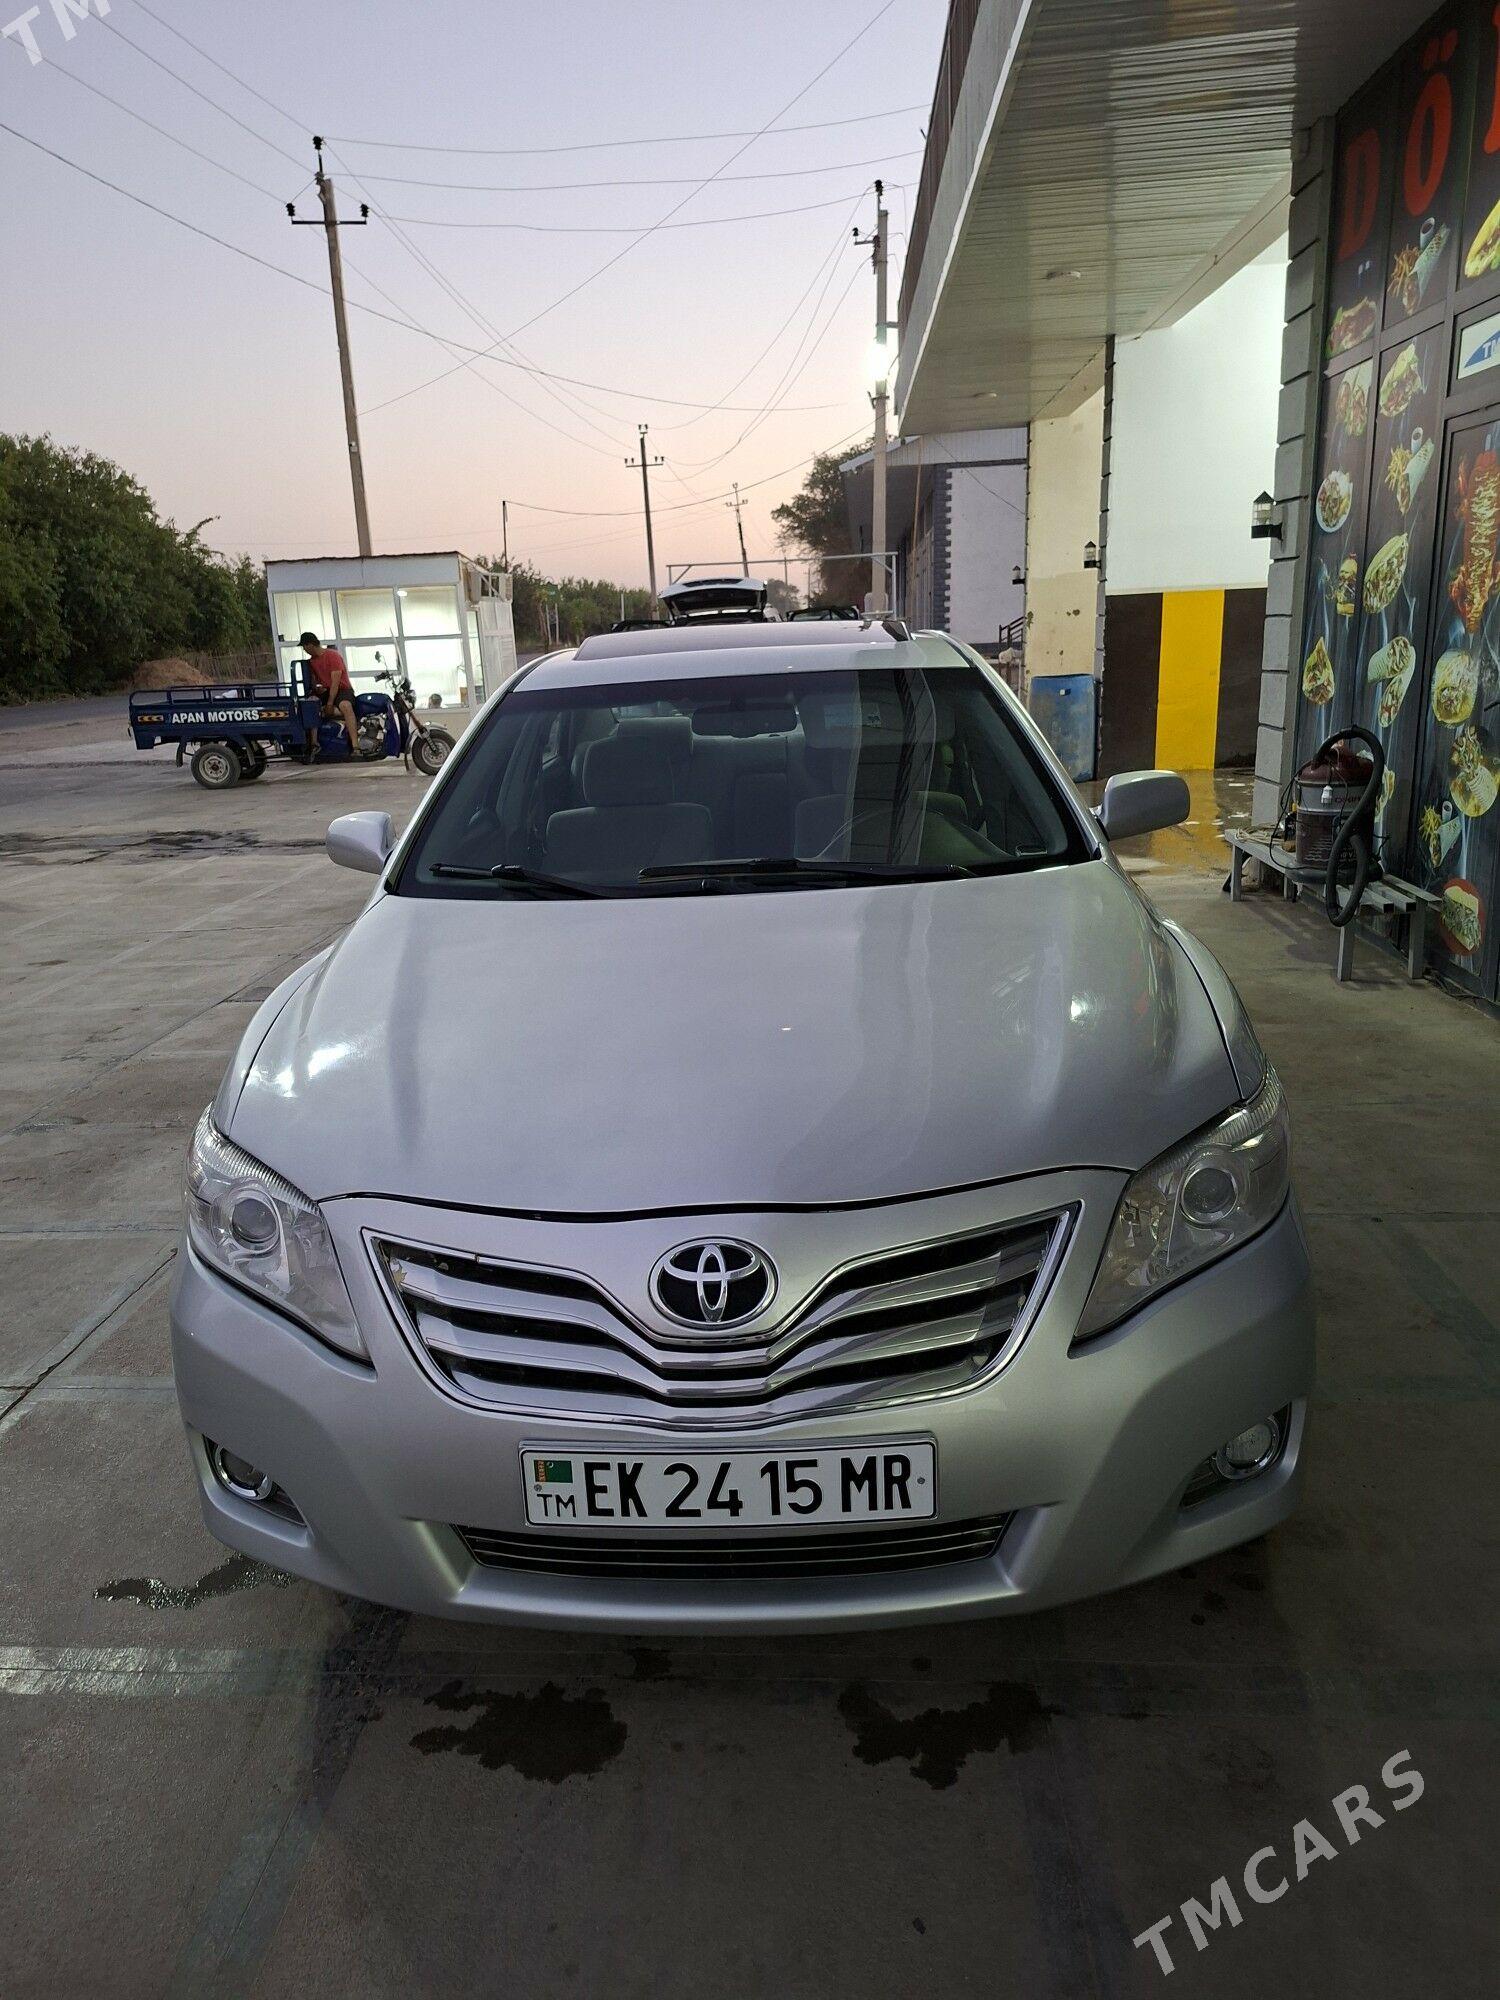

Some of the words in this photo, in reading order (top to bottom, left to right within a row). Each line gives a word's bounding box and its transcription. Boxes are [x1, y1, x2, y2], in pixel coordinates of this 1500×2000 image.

[208, 709, 260, 723] MOTORS
[583, 1461, 649, 1518] EK
[663, 1461, 744, 1518] 24
[760, 1458, 823, 1516] 15
[840, 1454, 912, 1513] MR
[536, 1493, 577, 1518] TM
